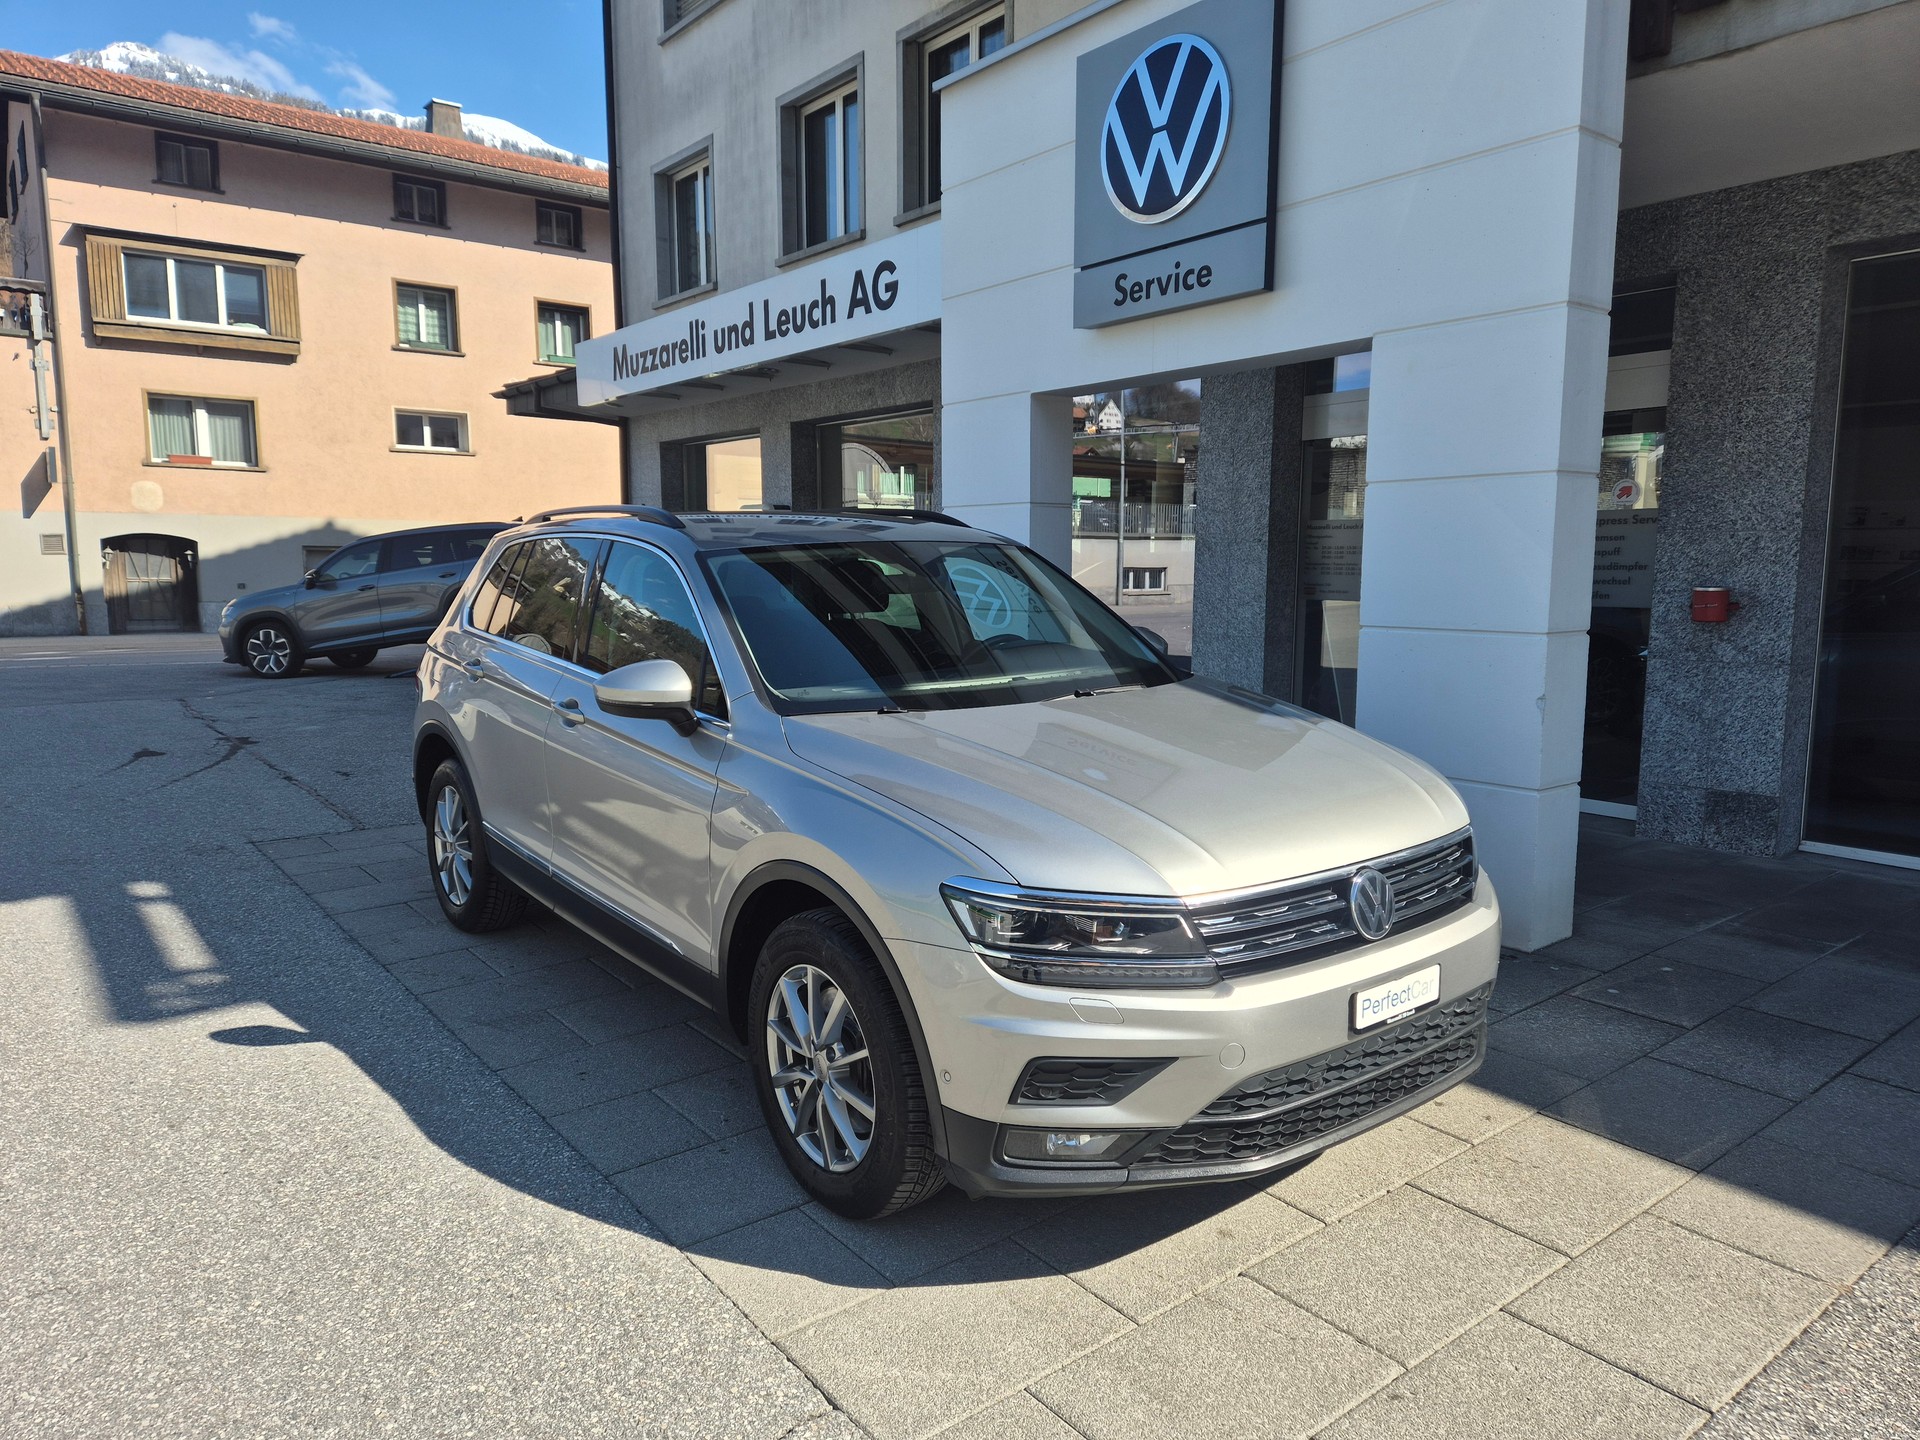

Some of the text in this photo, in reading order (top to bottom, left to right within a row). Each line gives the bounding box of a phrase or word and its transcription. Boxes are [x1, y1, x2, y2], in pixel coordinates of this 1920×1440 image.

[1104, 36, 1228, 216] VW
[613, 259, 899, 382] Muzzarelli und Leuch AG
[1113, 261, 1213, 306] Service
[1361, 978, 1435, 1019] PerfectCar
